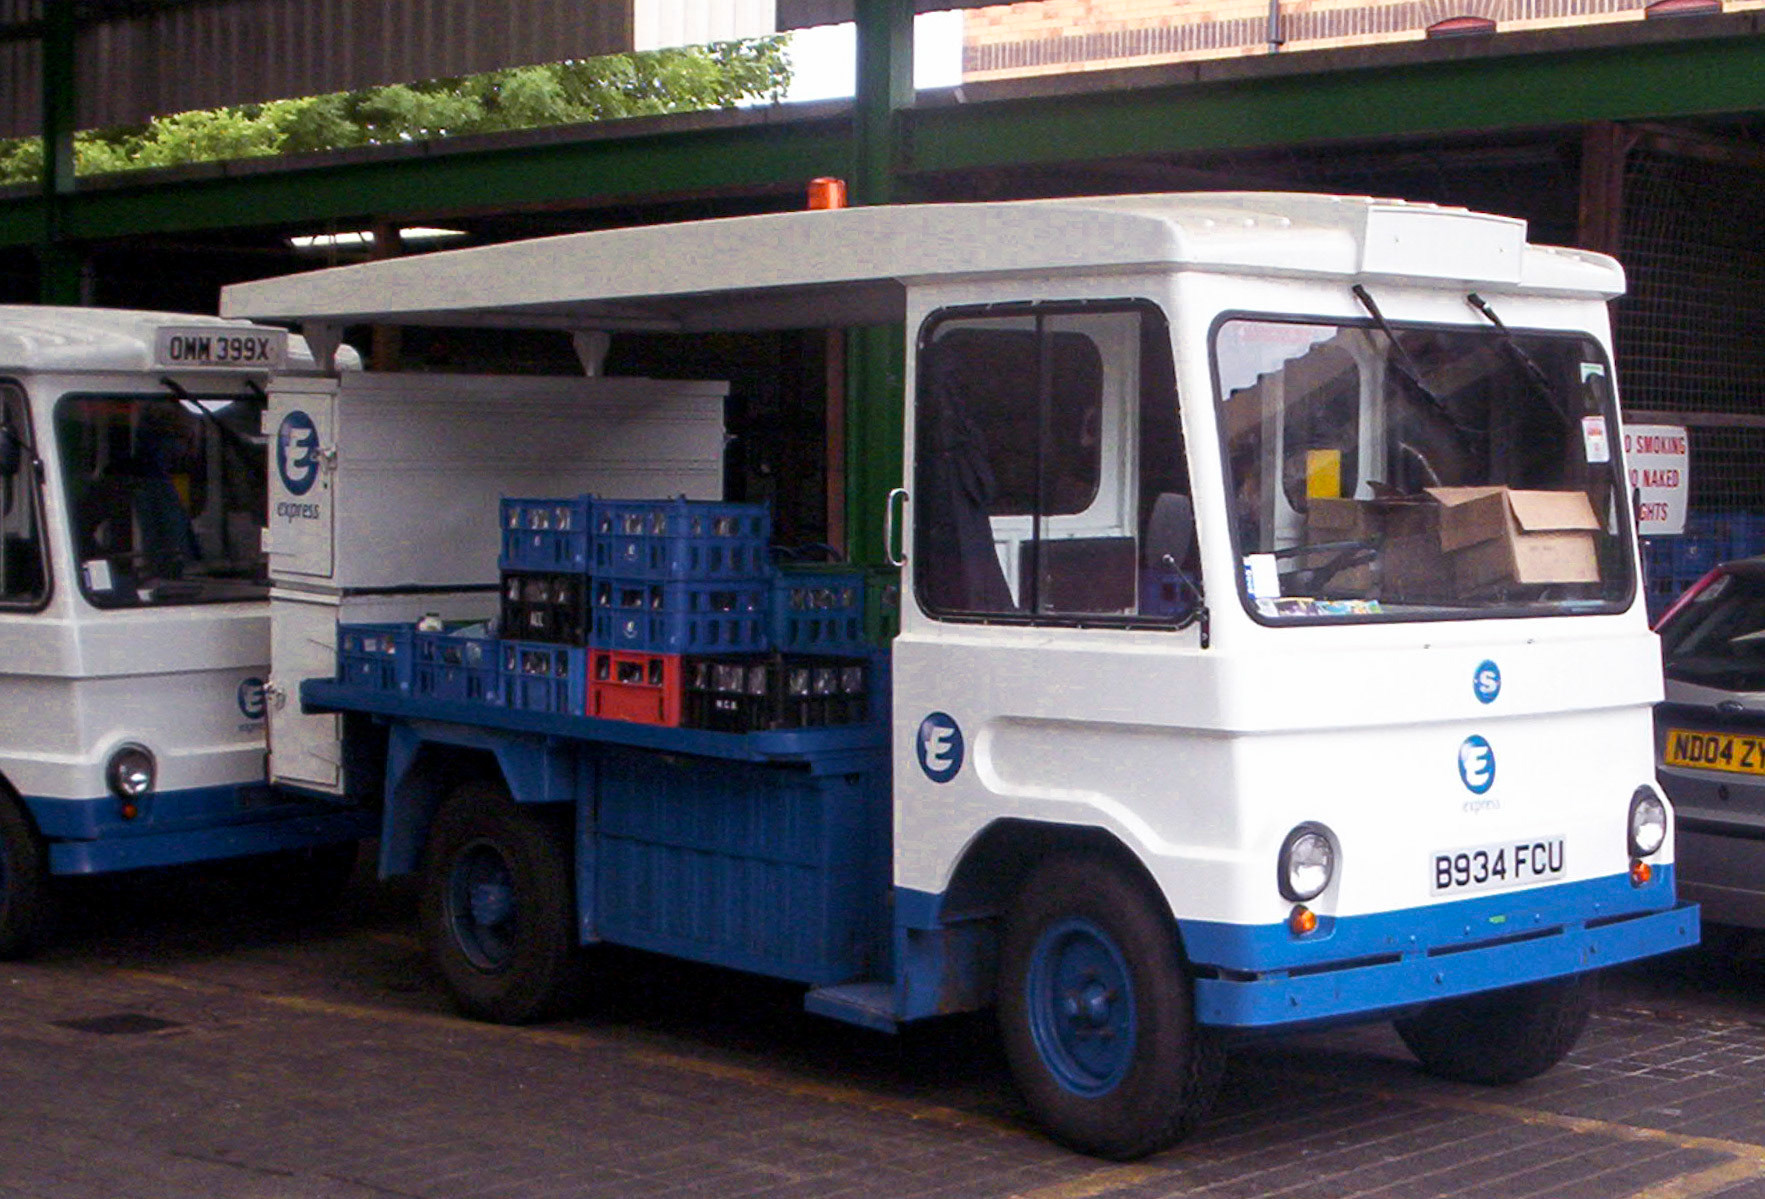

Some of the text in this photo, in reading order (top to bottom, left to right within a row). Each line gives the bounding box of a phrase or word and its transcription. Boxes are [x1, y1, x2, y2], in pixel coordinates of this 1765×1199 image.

[170, 336, 269, 361] OMM 399X
[1636, 435, 1686, 455] SMOKING
[1643, 469, 1681, 488] NAKED
[277, 502, 320, 524] express
[1639, 502, 1669, 522] GHTS
[1673, 733, 1733, 766] ND04
[1435, 840, 1564, 889] B934 FCU
